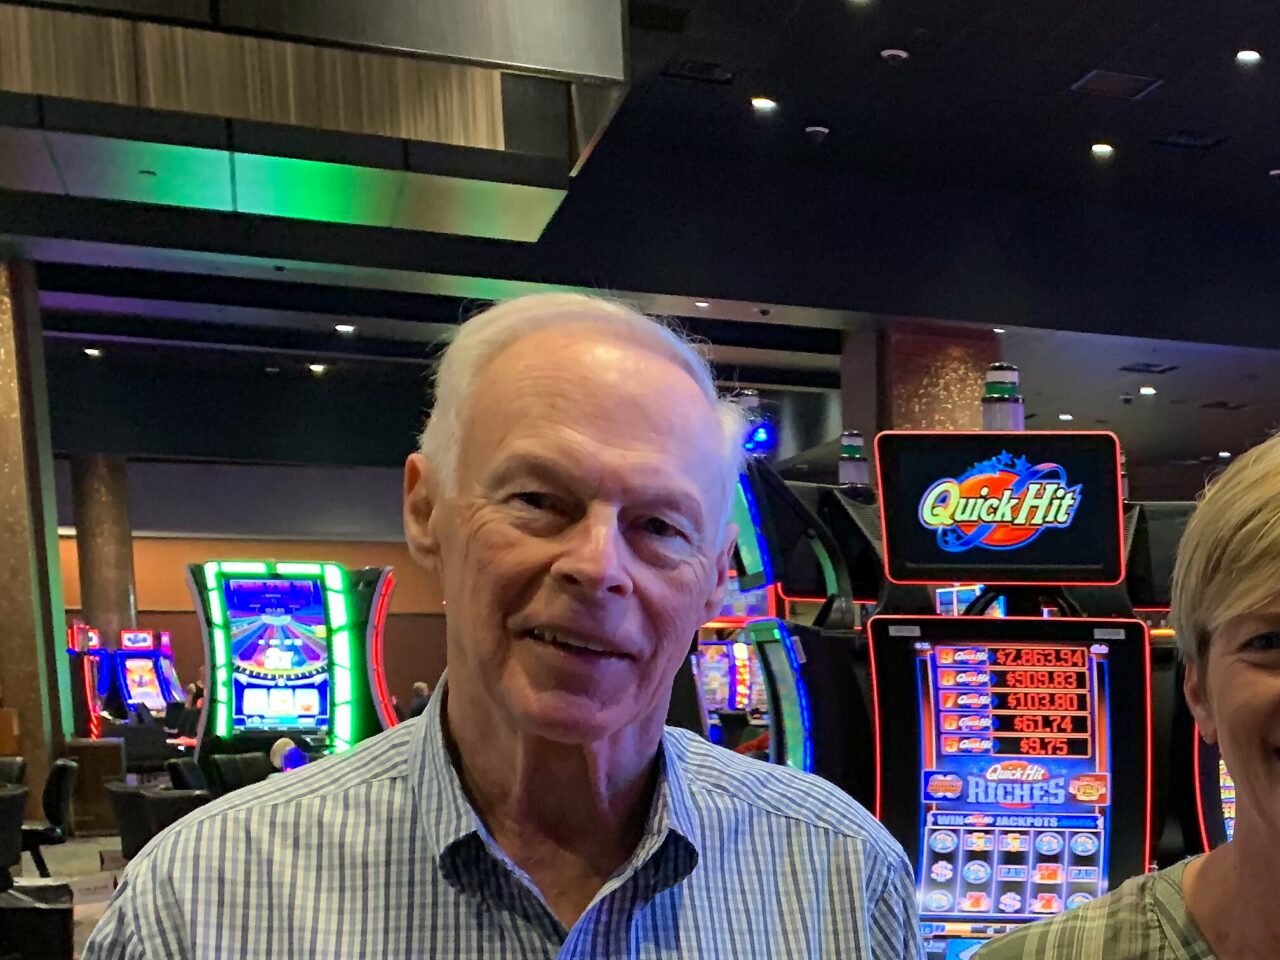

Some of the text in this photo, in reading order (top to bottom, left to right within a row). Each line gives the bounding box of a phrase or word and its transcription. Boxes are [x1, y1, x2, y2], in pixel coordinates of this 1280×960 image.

[921, 481, 1076, 526] Quick Hit
[1006, 671, 1077, 688] $909.83
[1008, 693, 1077, 711] $103.80
[1014, 715, 1072, 733] $61.74
[1020, 737, 1068, 755] $9.75
[985, 763, 1045, 781] Quick Hit
[966, 776, 1066, 805] RICHES
[937, 814, 964, 826] WIN
[995, 816, 1058, 827] JACKPOTS
